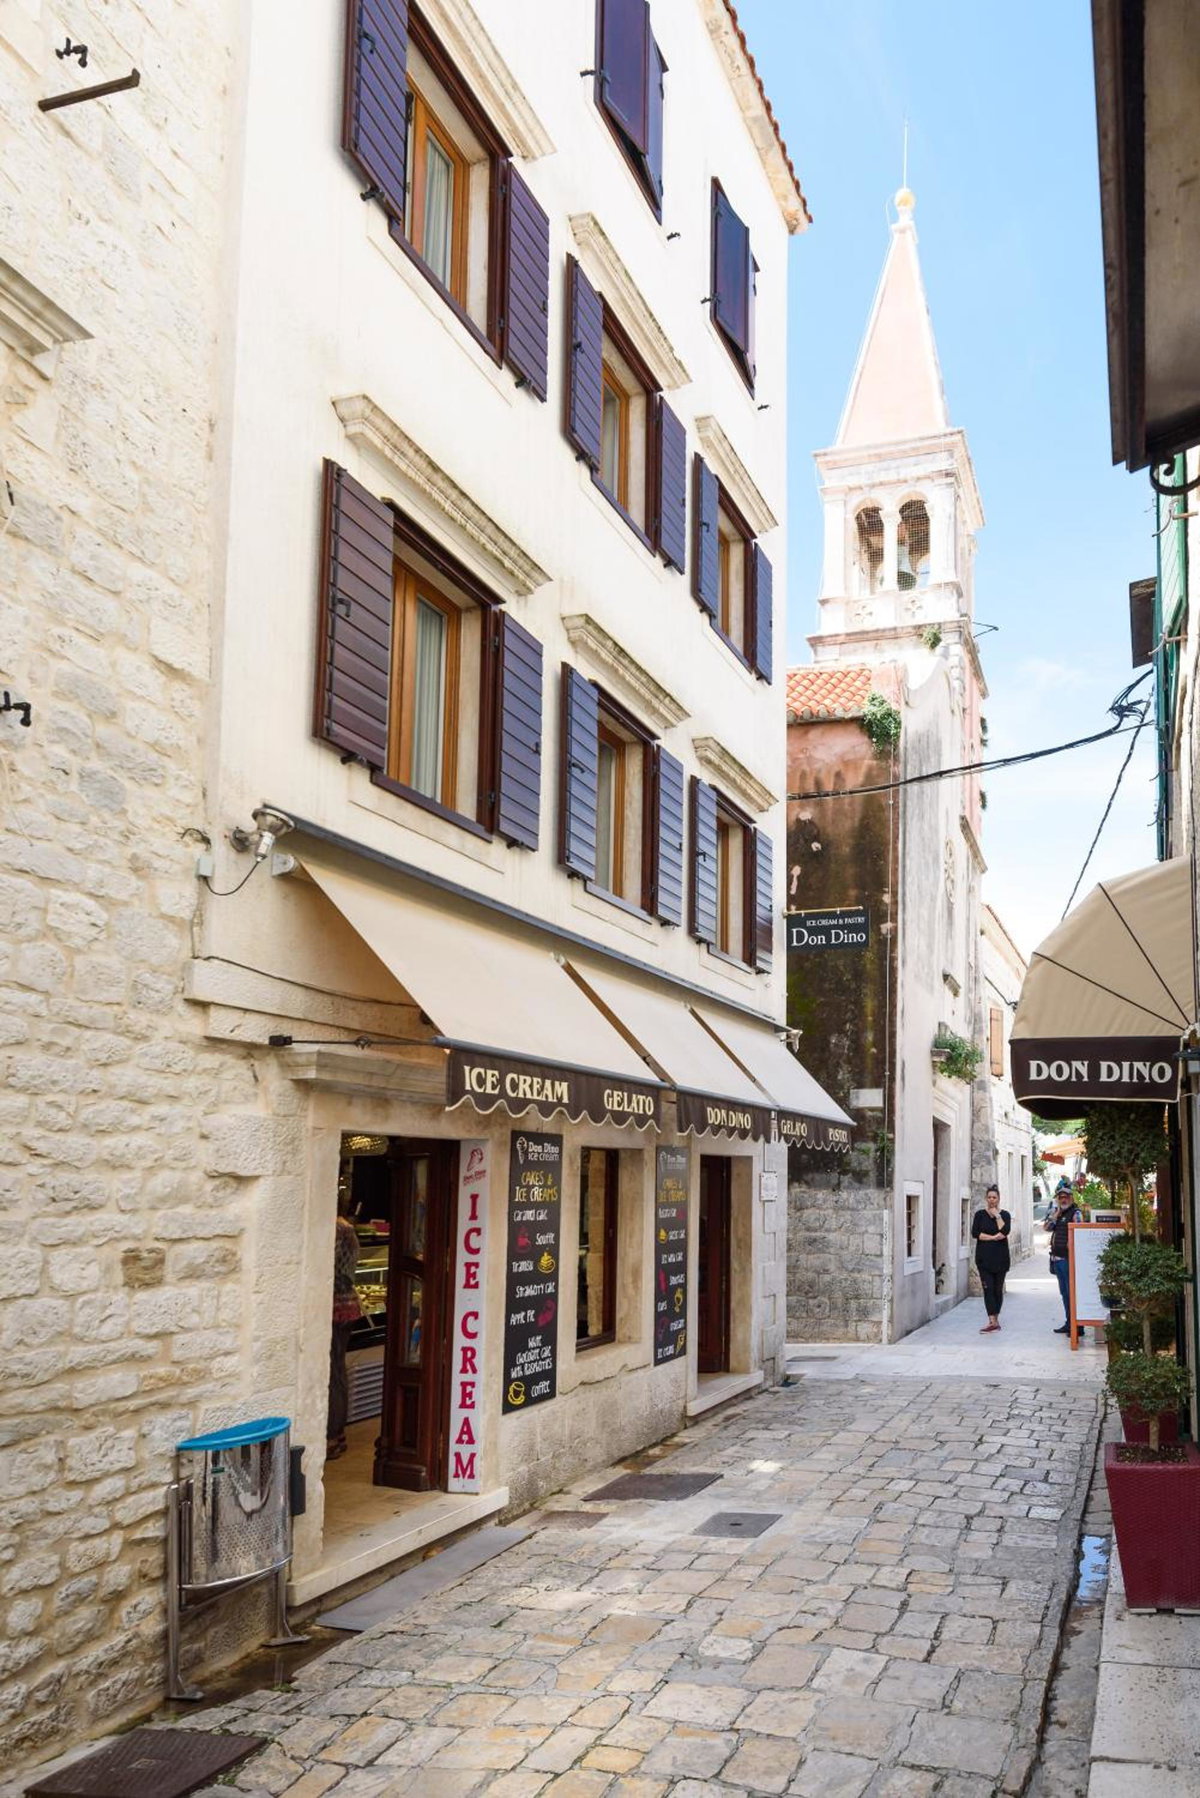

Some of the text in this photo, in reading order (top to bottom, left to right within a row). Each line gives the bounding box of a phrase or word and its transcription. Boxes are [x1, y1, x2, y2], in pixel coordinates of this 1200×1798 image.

[845, 916, 865, 924] PASTRY
[791, 927, 867, 947] Don Dino
[1028, 1060, 1173, 1083] DON DINO
[463, 1065, 570, 1103] ICE CREAM
[603, 1089, 655, 1115] GELATO
[706, 1107, 752, 1129] DON DINO
[528, 1141, 560, 1153] Don Dino
[521, 1170, 545, 1186] CAKES
[515, 1186, 558, 1202] ICE CREAMS
[453, 1193, 481, 1480] ICE CREAM
